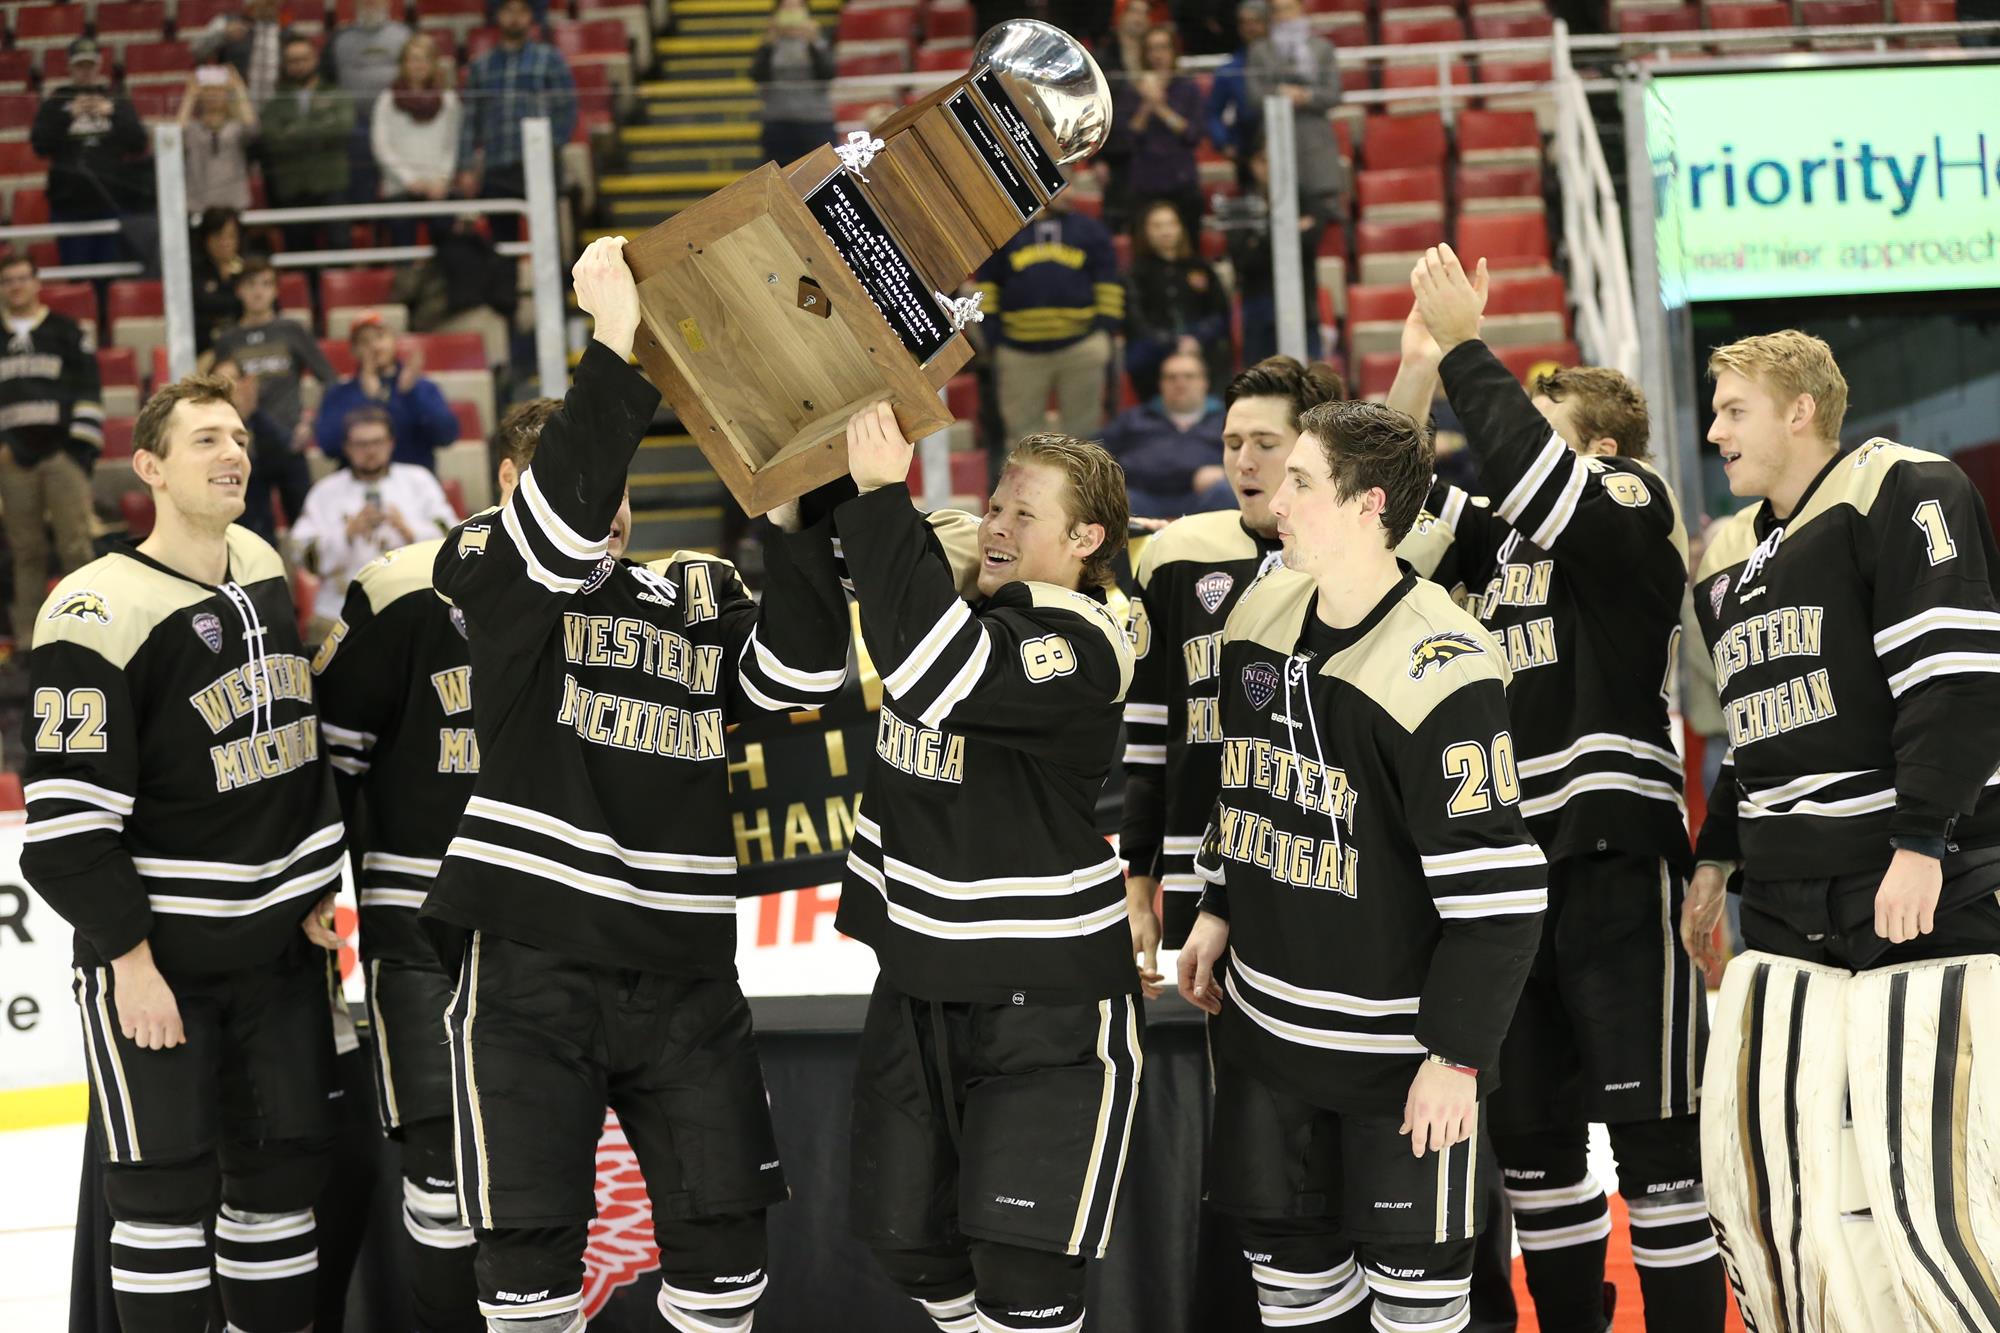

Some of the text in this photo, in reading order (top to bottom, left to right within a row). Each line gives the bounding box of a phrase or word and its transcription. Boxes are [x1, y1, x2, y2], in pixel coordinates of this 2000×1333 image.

[972, 118, 994, 149] University
[999, 159, 1019, 187] Michigan
[823, 203, 837, 219] JOE
[835, 219, 852, 242] LOUIS
[851, 244, 870, 269] ARENA
[897, 309, 924, 346] MICHIGAN
[831, 183, 941, 342] GREAT LAKES INVITATIONAL
[833, 201, 871, 251] HOCKEY
[868, 252, 927, 333] TOURNAMENT
[876, 233, 910, 281] ANNUAL
[1912, 499, 1958, 567] 1
[684, 562, 719, 628] A
[563, 612, 724, 695] WESTERN
[1019, 633, 1078, 684] 8
[1245, 668, 1280, 690] NCHC
[33, 687, 107, 753] 22
[1221, 737, 1359, 837] WETERN
[1442, 730, 1521, 820] 20
[1218, 801, 1359, 900] MICIGAN
[1373, 1201, 1413, 1209] BAUER
[1646, 1179, 1695, 1194] BAUER
[495, 1289, 550, 1303] BAUER
